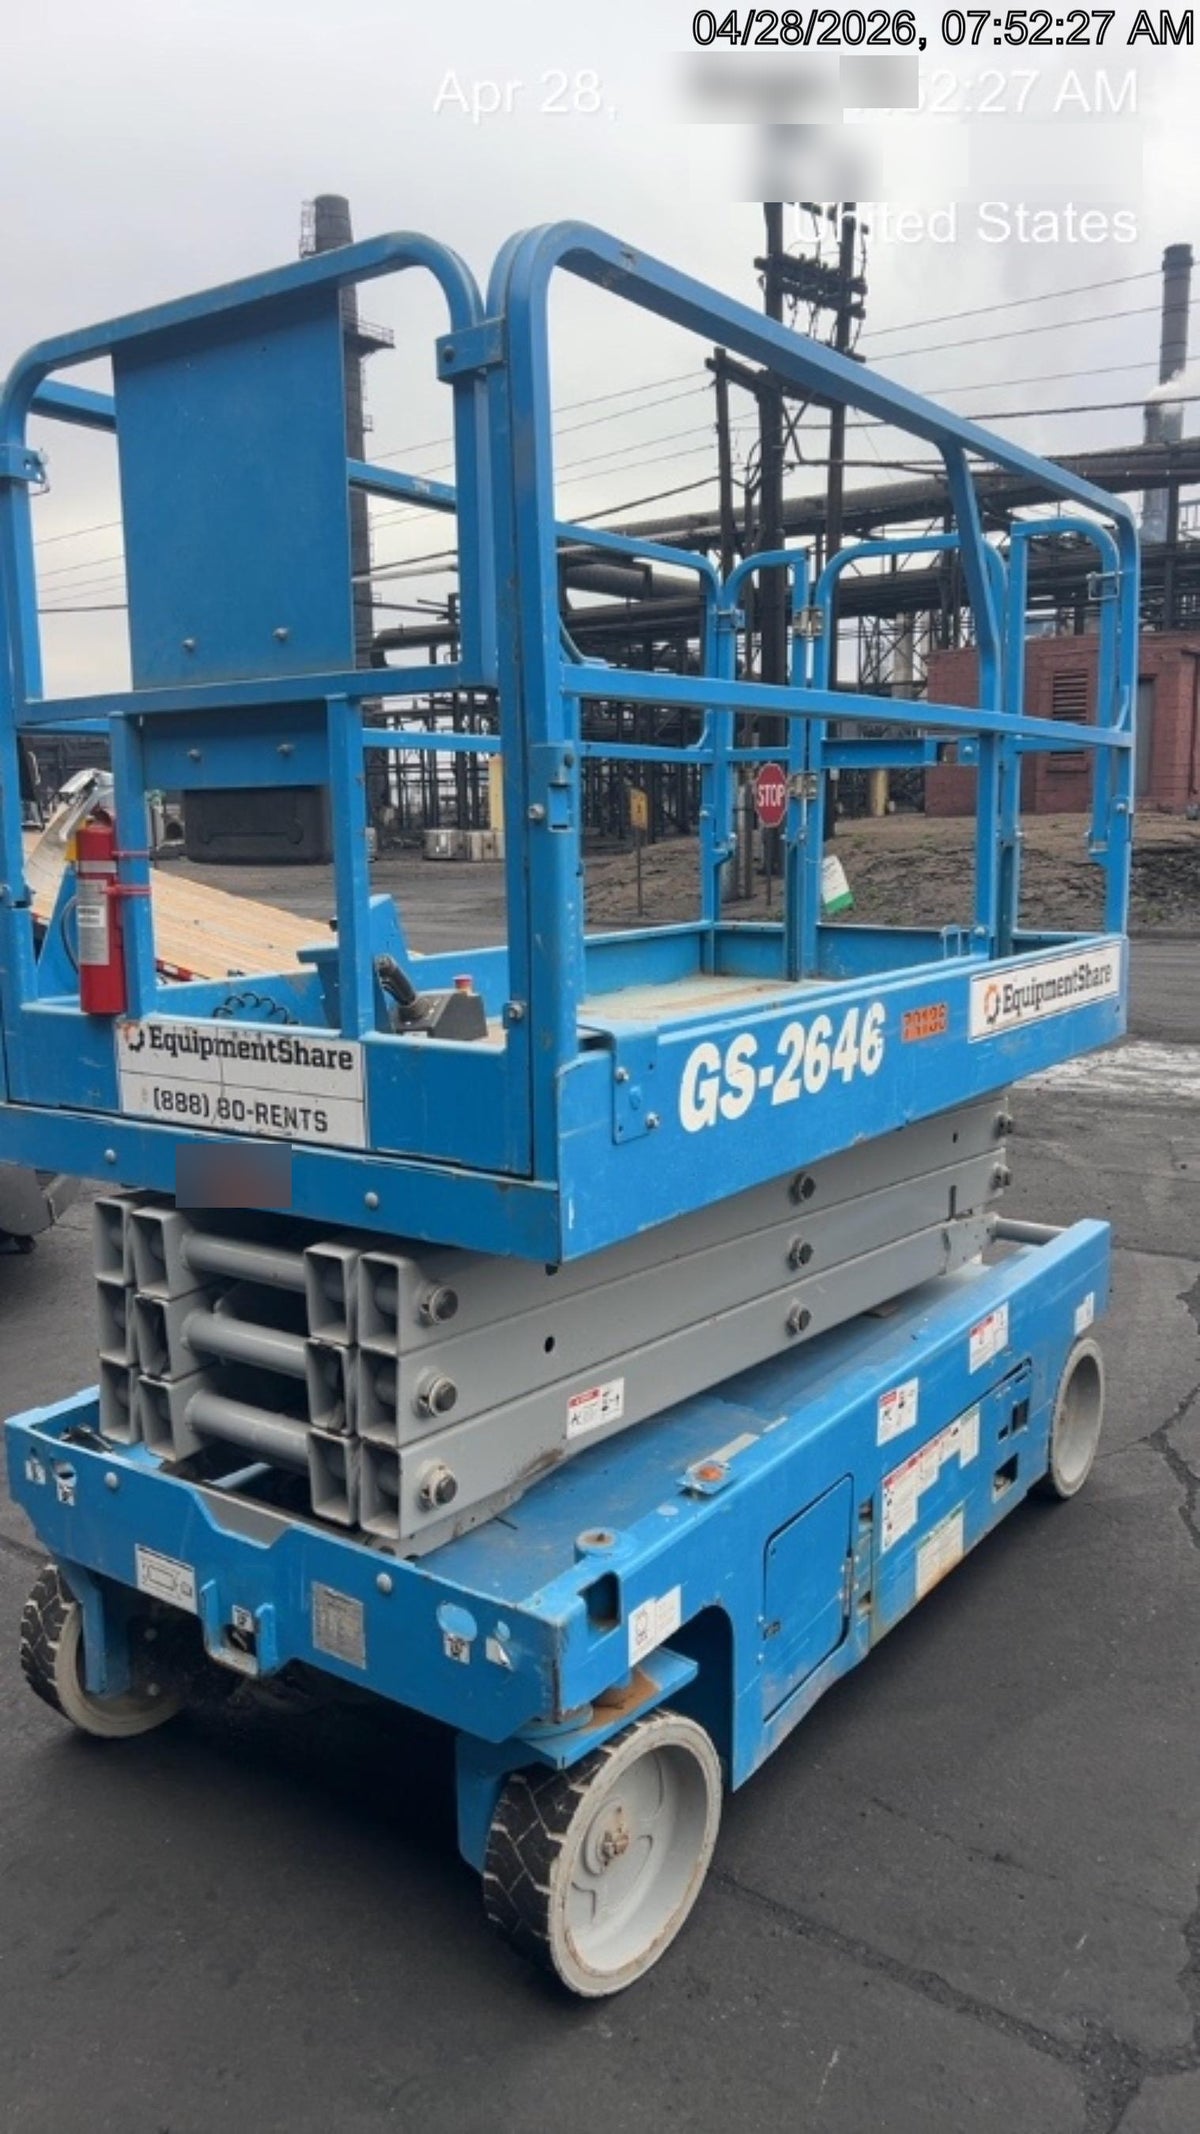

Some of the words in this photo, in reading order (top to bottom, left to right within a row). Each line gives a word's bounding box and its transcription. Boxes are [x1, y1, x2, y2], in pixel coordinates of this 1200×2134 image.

[757, 784, 784, 807] STOP
[1002, 962, 1113, 1017] EquipmentShare
[148, 1024, 354, 1071] EquipmentShare
[678, 1001, 886, 1133] GS-2646
[153, 1087, 210, 1118] (888)
[218, 1099, 328, 1133] 80-RENTS
